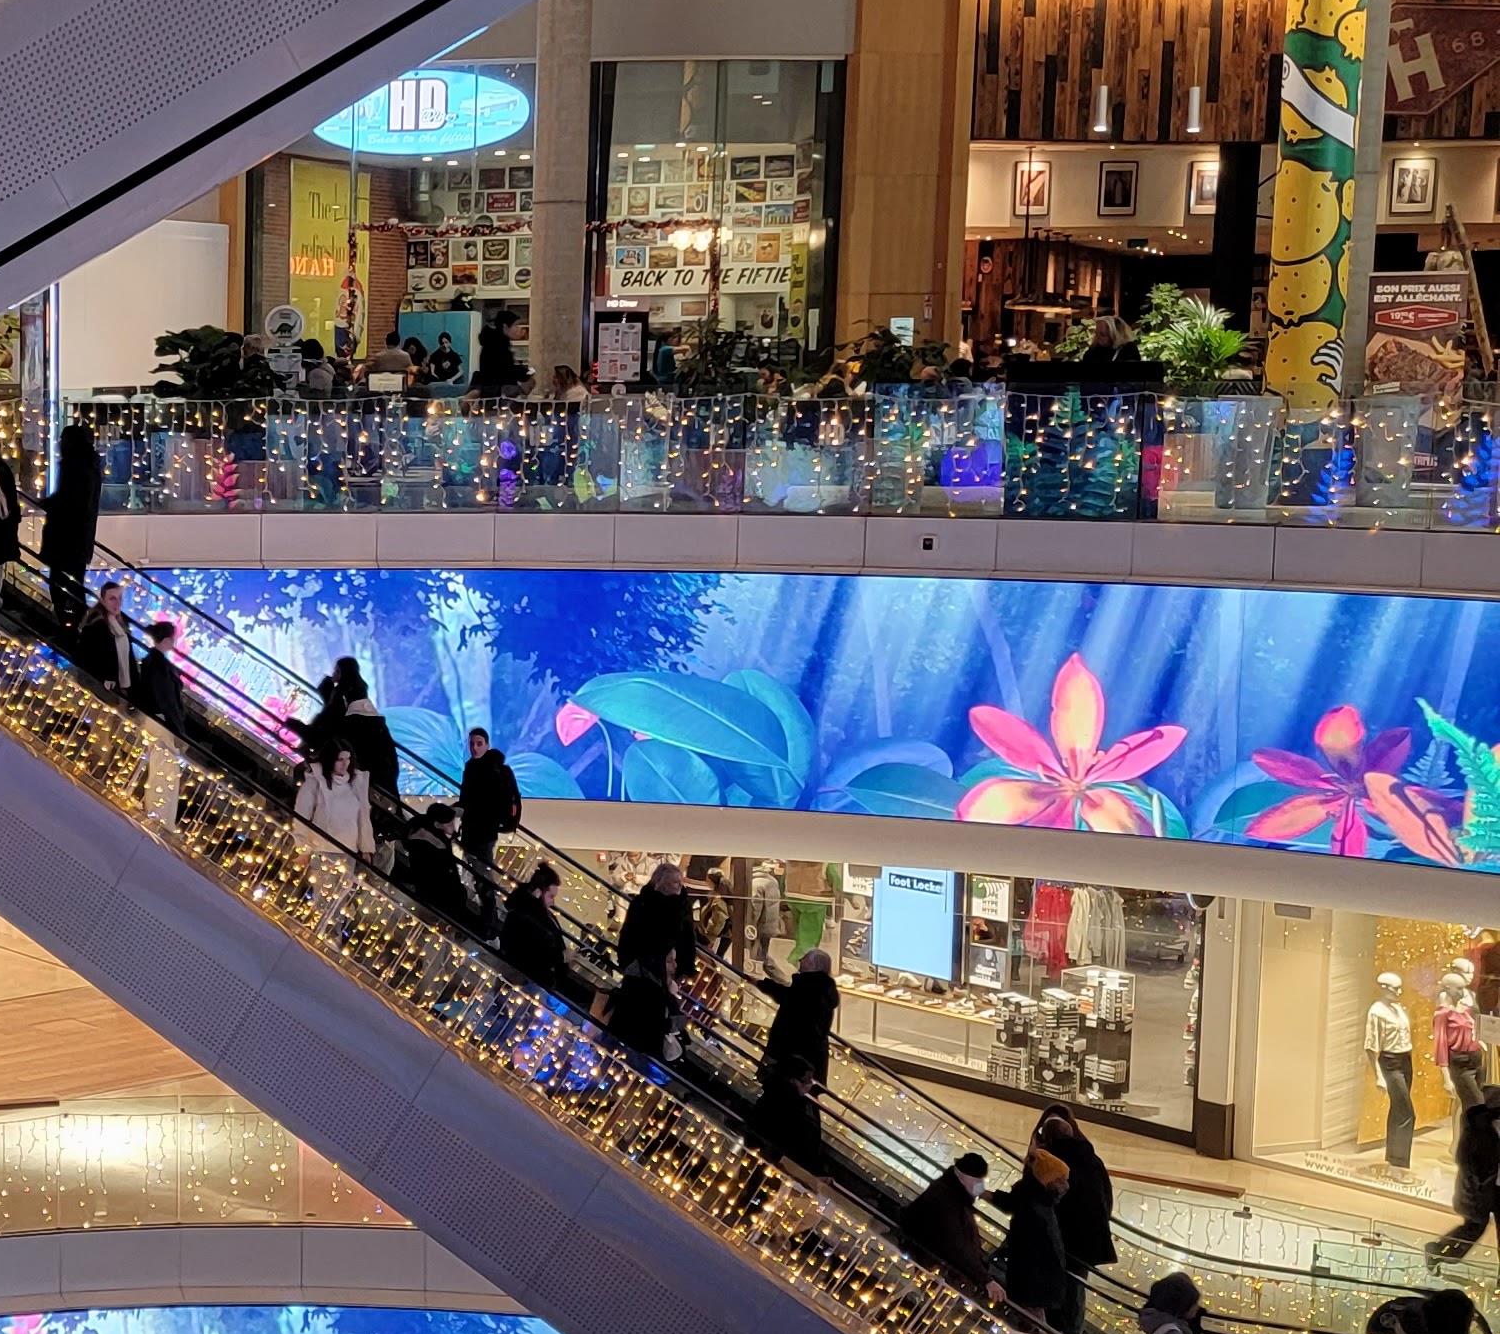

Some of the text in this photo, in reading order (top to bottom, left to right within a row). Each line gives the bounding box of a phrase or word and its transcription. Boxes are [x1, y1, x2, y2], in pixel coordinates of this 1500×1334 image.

[388, 78, 448, 132] HD
[367, 133, 398, 145] Back
[402, 134, 414, 144] to
[418, 133, 436, 144] the
[309, 191, 331, 220] The
[620, 269, 668, 287] BACK
[673, 269, 694, 285] TO
[737, 266, 791, 284] FIFTIE
[1376, 283, 1461, 293] SON PRIX AUSSI
[1373, 292, 1462, 303] EST ALLÉCHANT.
[890, 875, 942, 893] Foot Locke
[982, 907, 998, 915] HYPE
